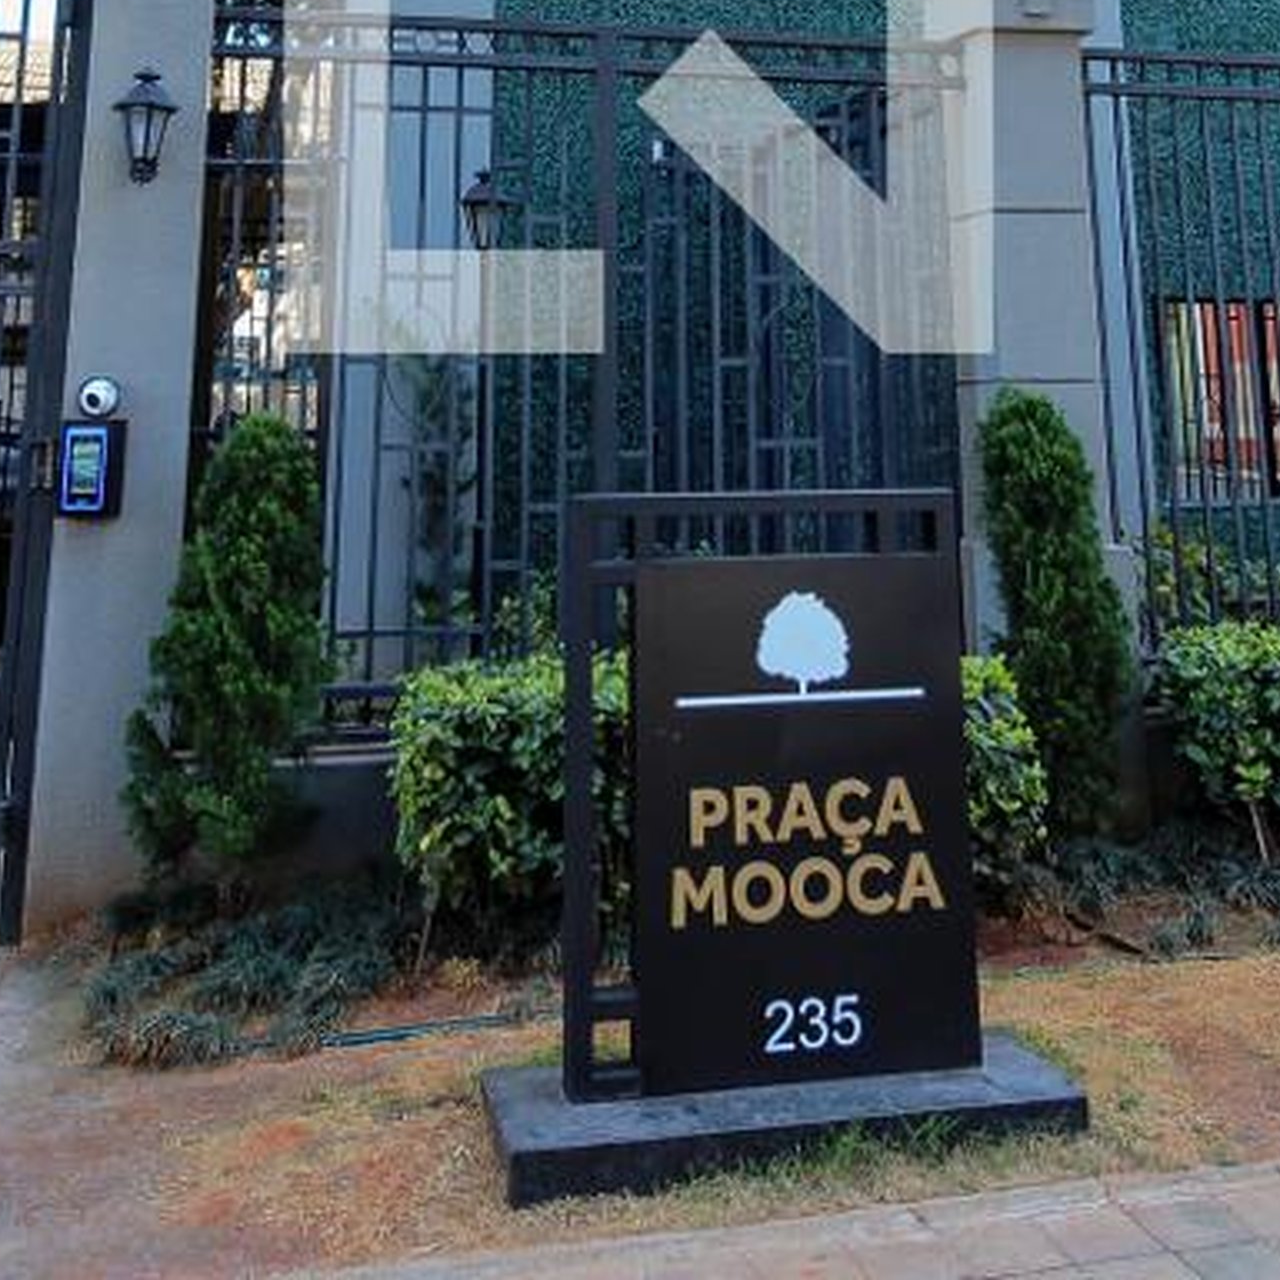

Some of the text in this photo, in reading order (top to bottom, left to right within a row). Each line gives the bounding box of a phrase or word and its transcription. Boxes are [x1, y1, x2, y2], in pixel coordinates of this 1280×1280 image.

[690, 776, 923, 855] PRAÇA
[671, 851, 945, 928] MOOCA
[763, 993, 863, 1053] 235
